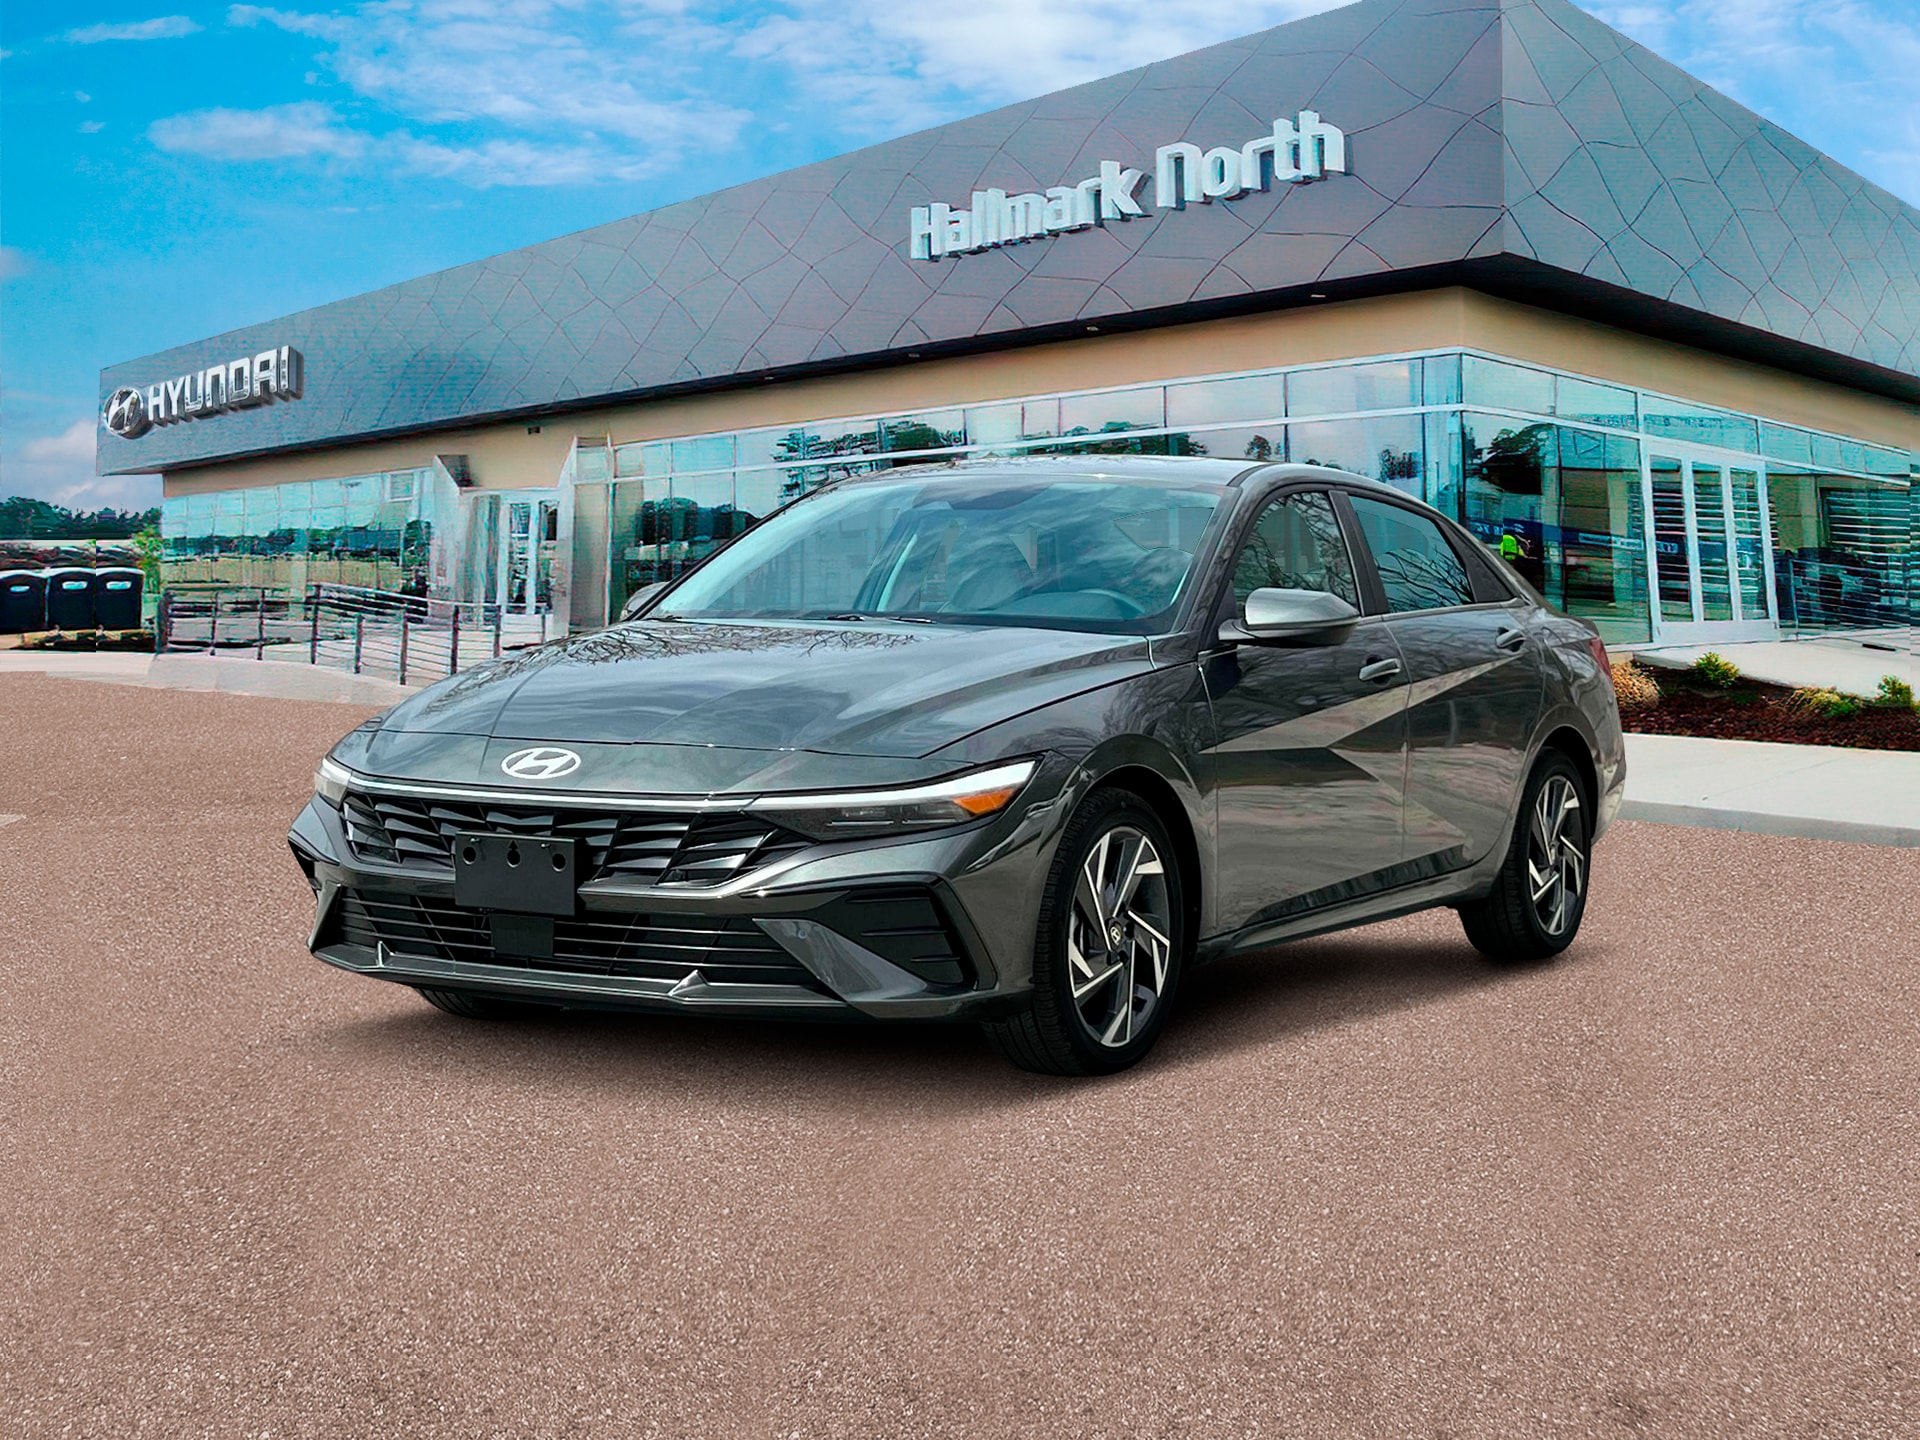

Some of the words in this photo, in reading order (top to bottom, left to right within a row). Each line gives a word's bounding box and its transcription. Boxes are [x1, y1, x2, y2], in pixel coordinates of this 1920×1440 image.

[910, 160, 1150, 261] Hallmark
[1156, 110, 1346, 209] North
[148, 345, 292, 422] HYUNDAI
